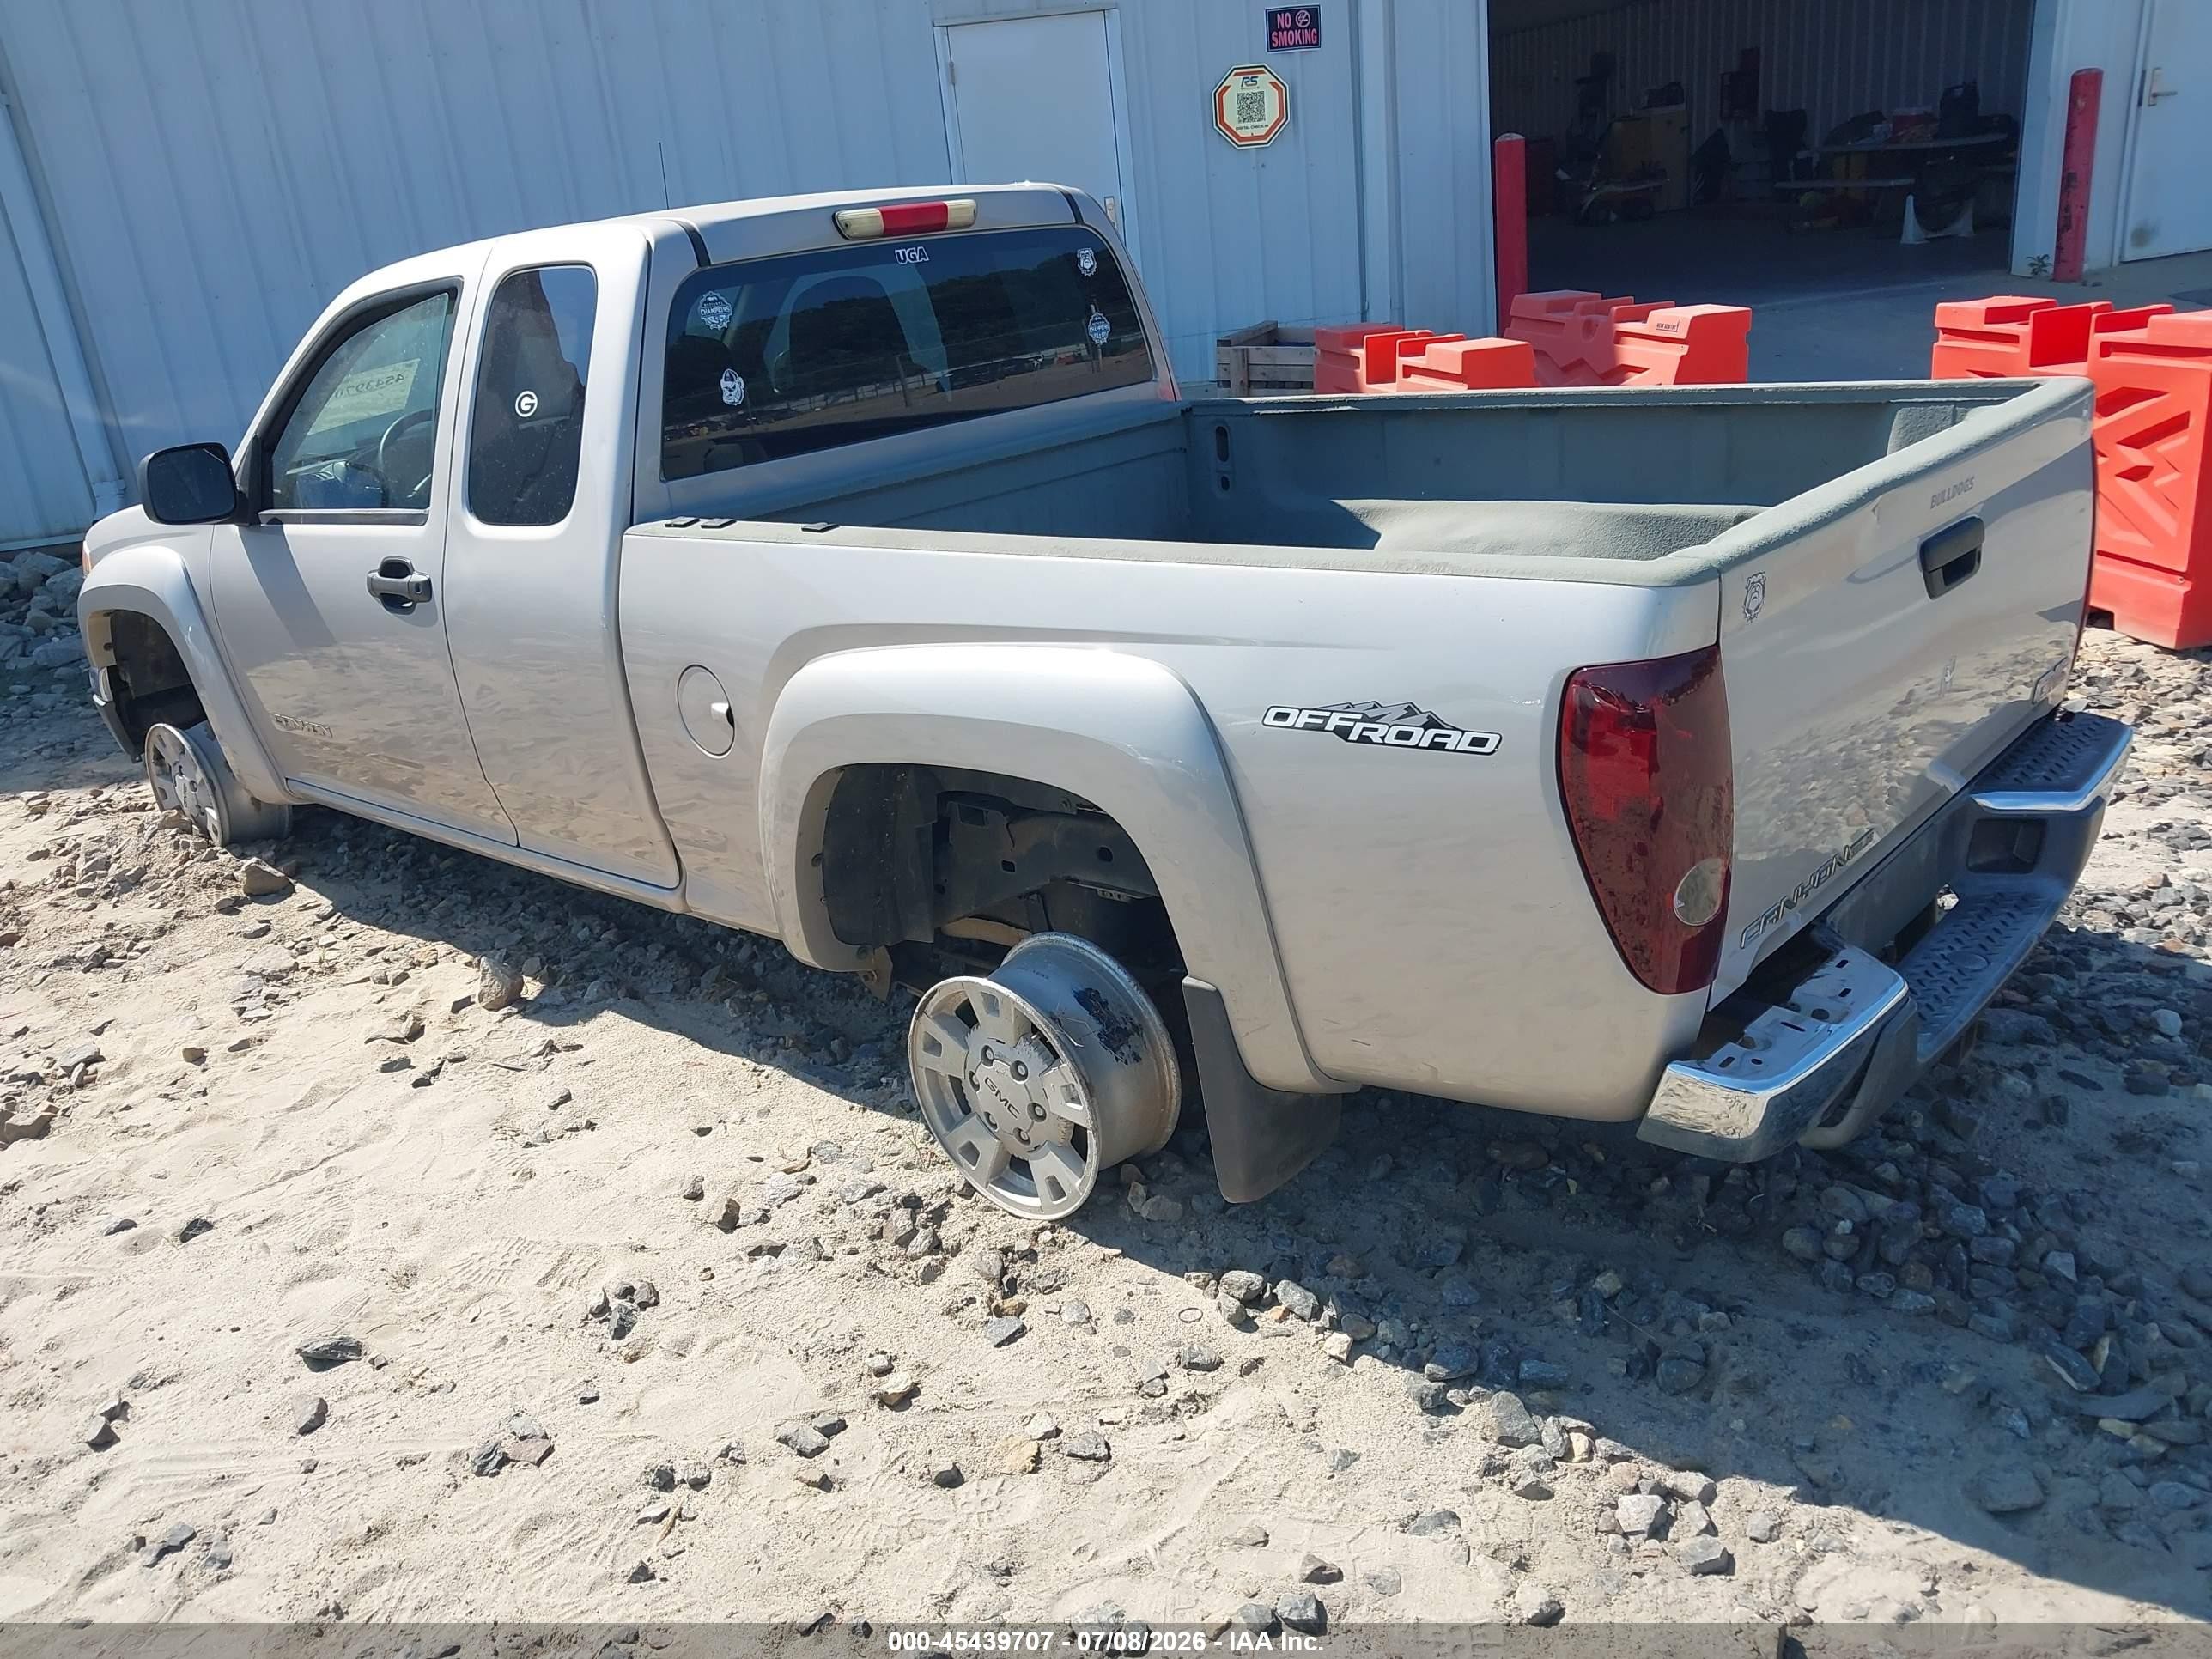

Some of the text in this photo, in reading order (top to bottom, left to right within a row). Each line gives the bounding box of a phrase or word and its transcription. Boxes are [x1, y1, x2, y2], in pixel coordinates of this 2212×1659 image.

[1277, 13, 1291, 29] NO
[1272, 28, 1317, 48] SMOKING
[895, 246, 929, 264] UGA
[1930, 476, 1975, 509] BULLDOGS
[985, 1077, 1020, 1120] GMC
